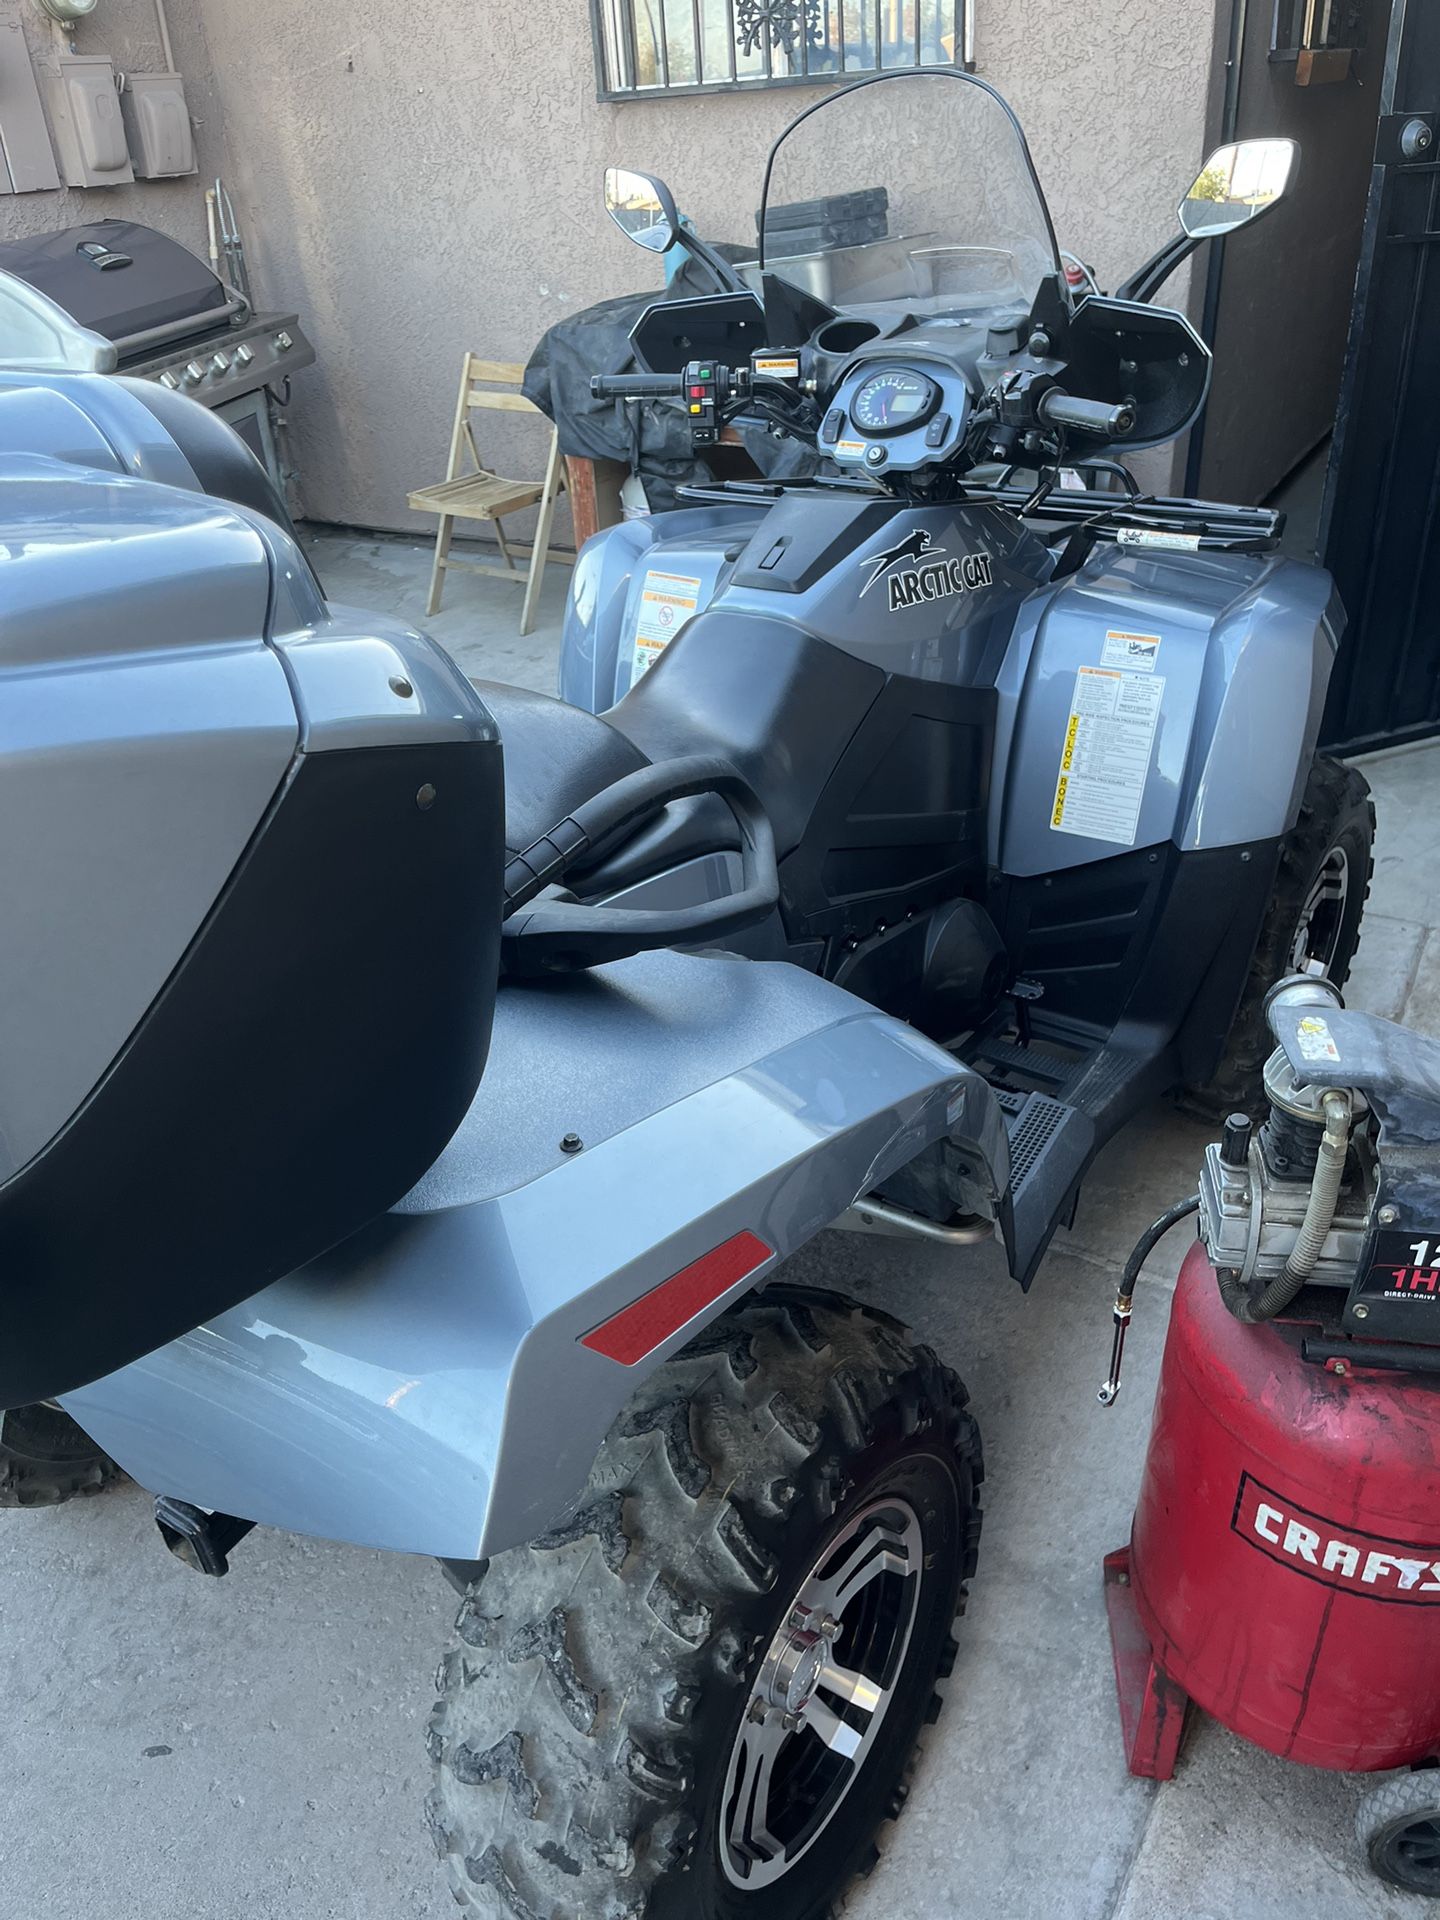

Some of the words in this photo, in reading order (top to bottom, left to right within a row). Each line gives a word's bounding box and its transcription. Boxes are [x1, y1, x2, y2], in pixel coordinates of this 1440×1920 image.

[888, 558, 963, 612] ARCTIC
[961, 552, 993, 591] CAT
[1391, 1268, 1440, 1292] 1H
[1384, 1290, 1436, 1300] DIRECT-DRIVE
